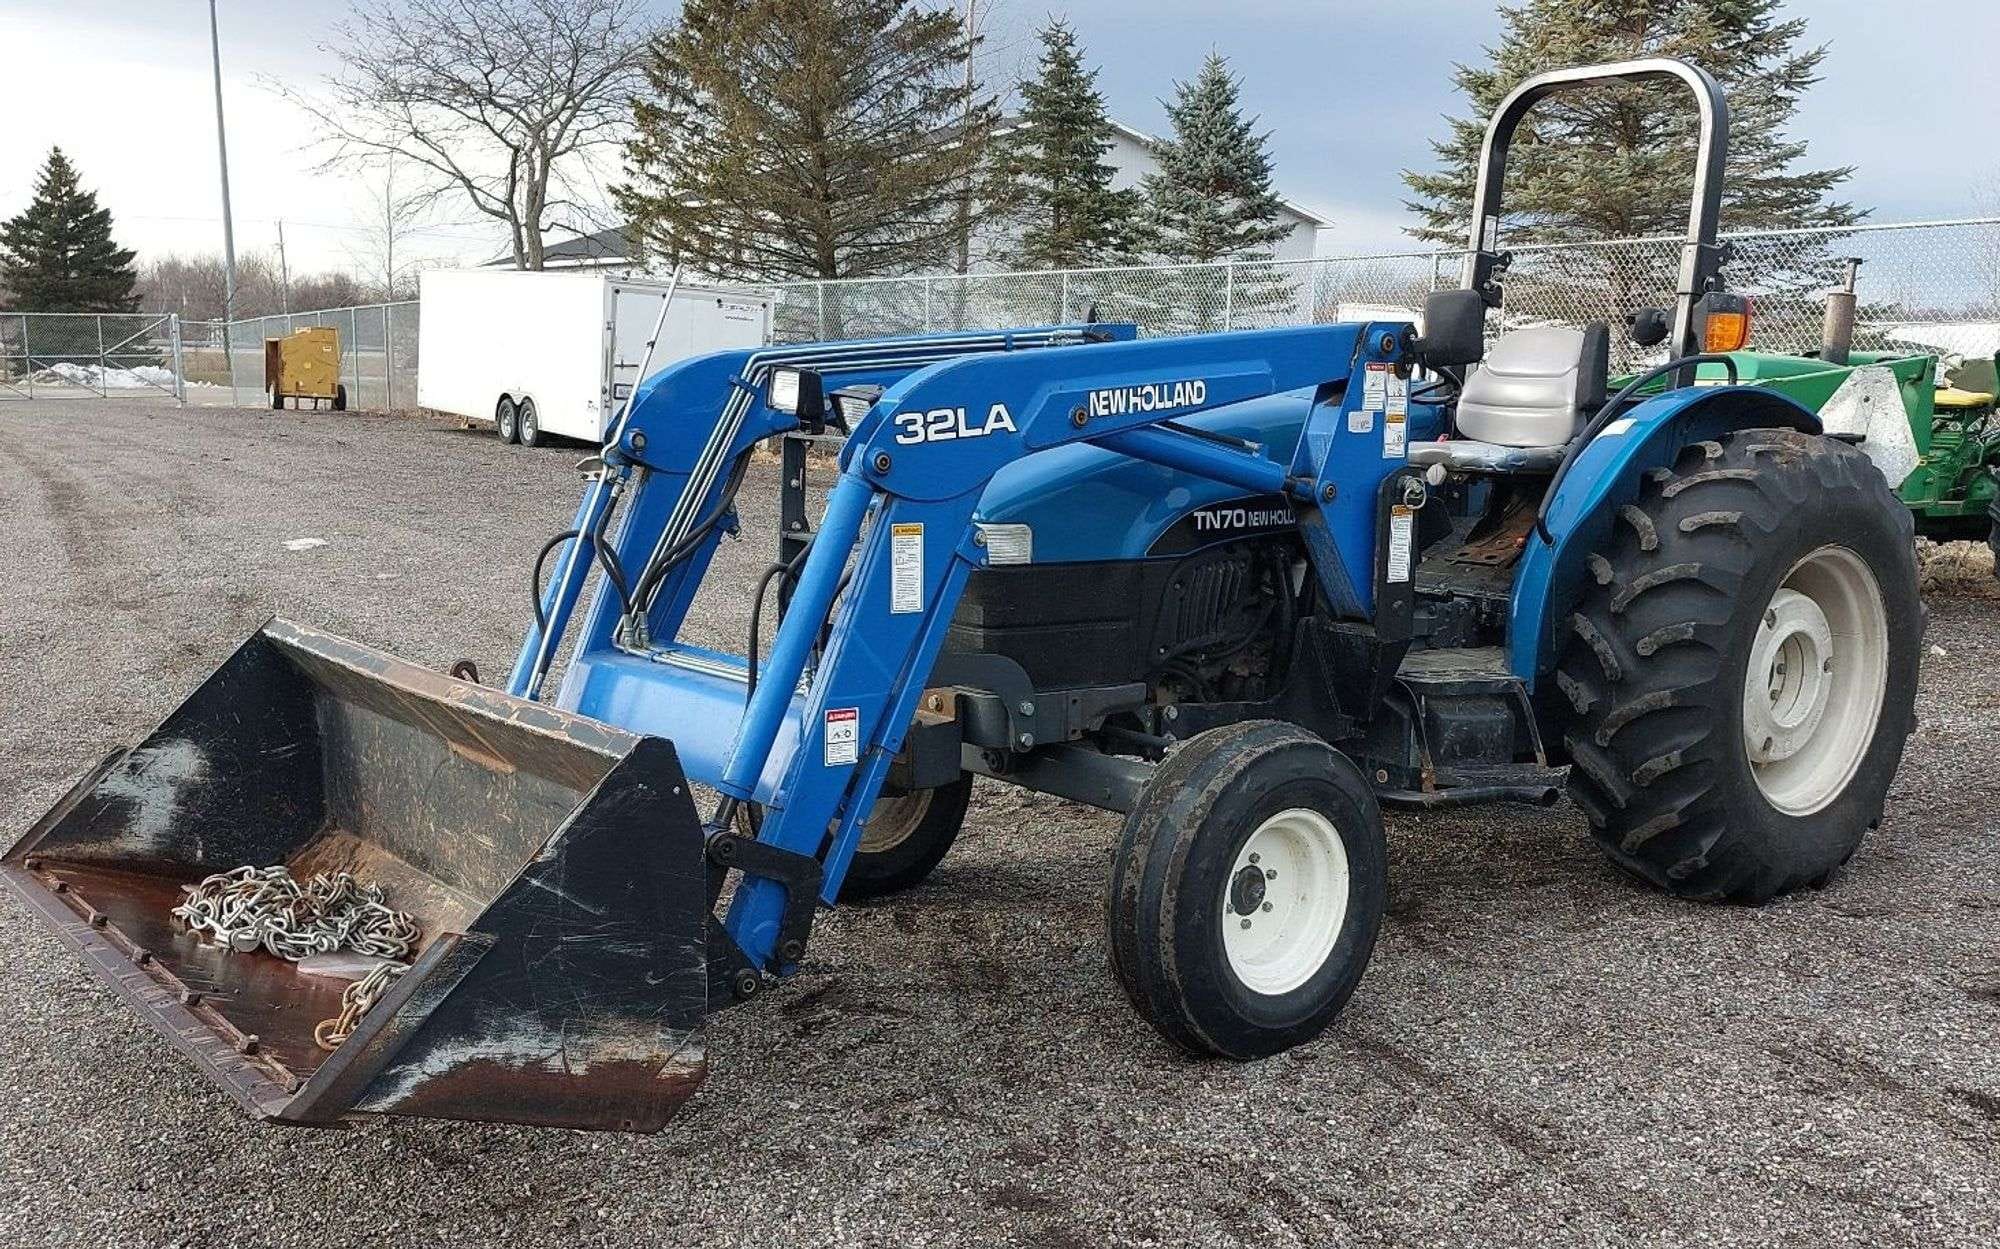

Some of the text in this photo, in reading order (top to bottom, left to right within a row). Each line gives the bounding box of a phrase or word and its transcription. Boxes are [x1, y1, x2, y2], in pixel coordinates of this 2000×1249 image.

[1089, 380, 1206, 418] NEW HOLLAND
[895, 403, 1016, 445] 32LA
[1193, 508, 1246, 530] TN70
[1248, 510, 1268, 527] NEW
